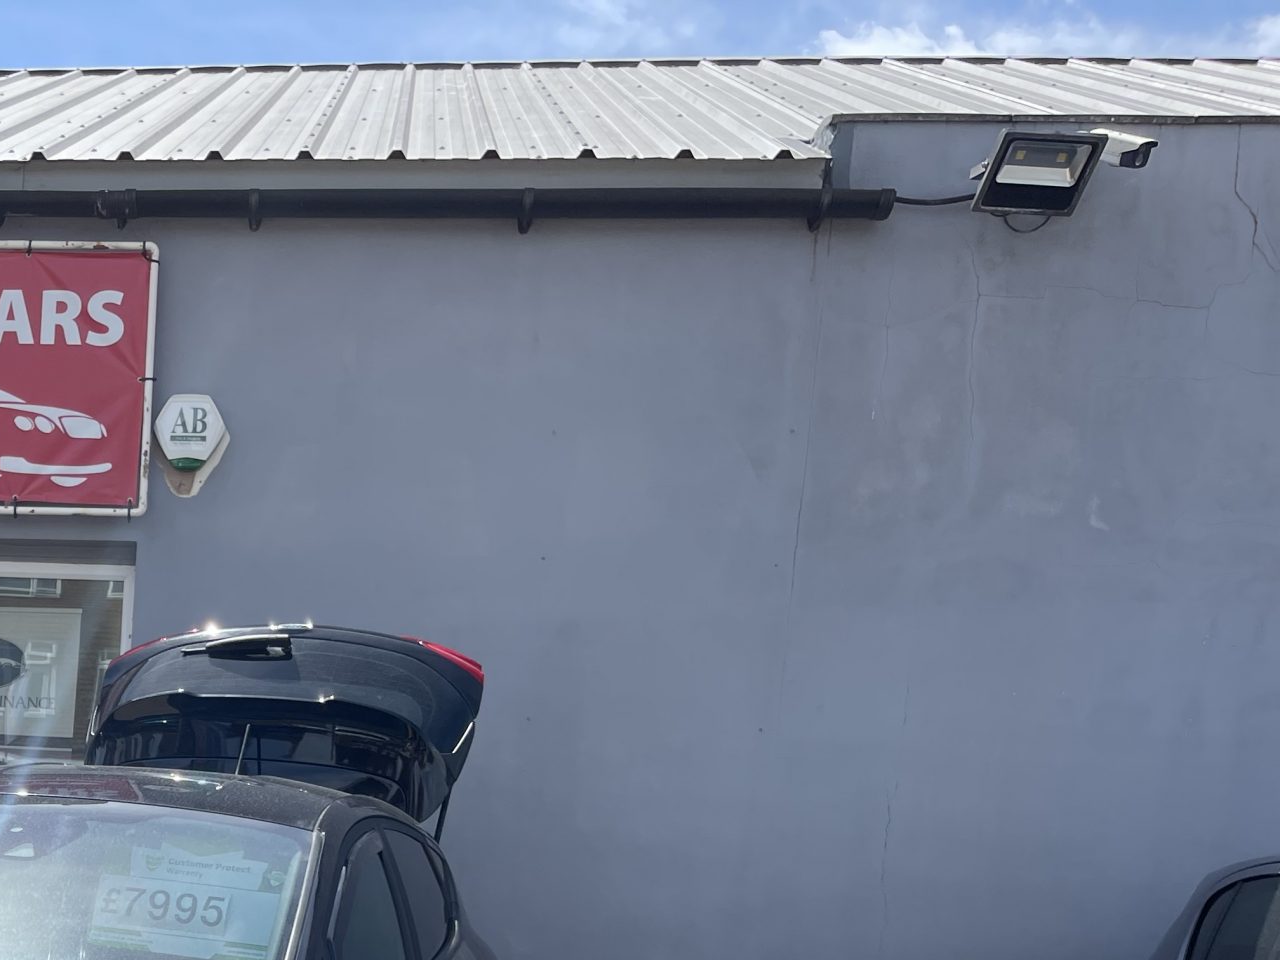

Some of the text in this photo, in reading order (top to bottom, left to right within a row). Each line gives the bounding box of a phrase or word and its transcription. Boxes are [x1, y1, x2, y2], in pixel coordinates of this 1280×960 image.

[170, 407, 208, 434] AB
[167, 857, 252, 874] Customer Protect
[100, 886, 225, 928] £7995
